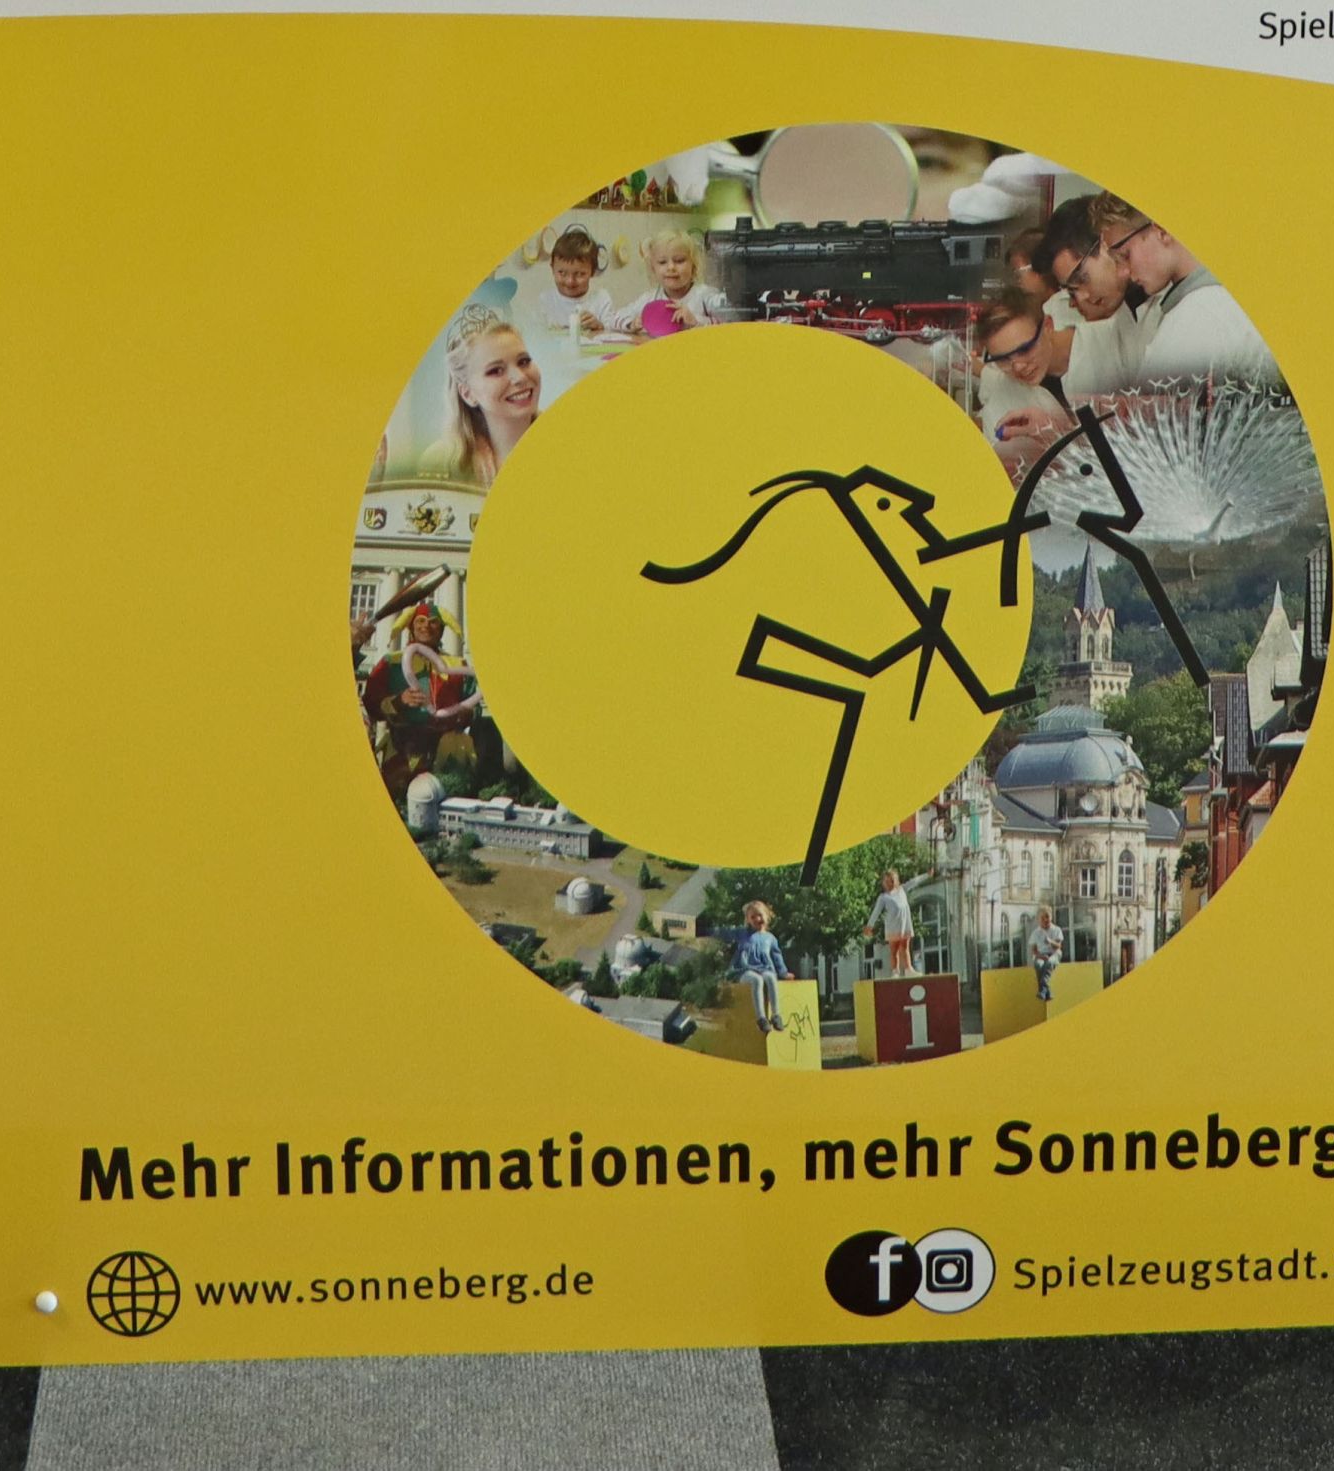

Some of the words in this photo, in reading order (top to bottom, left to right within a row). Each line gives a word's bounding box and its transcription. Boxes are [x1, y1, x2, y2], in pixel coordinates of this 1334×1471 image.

[79, 1141, 251, 1202] Mehr
[275, 1131, 777, 1199] Informationen,
[805, 1121, 972, 1182] mehr
[195, 1263, 595, 1306] www.sonneberg.de
